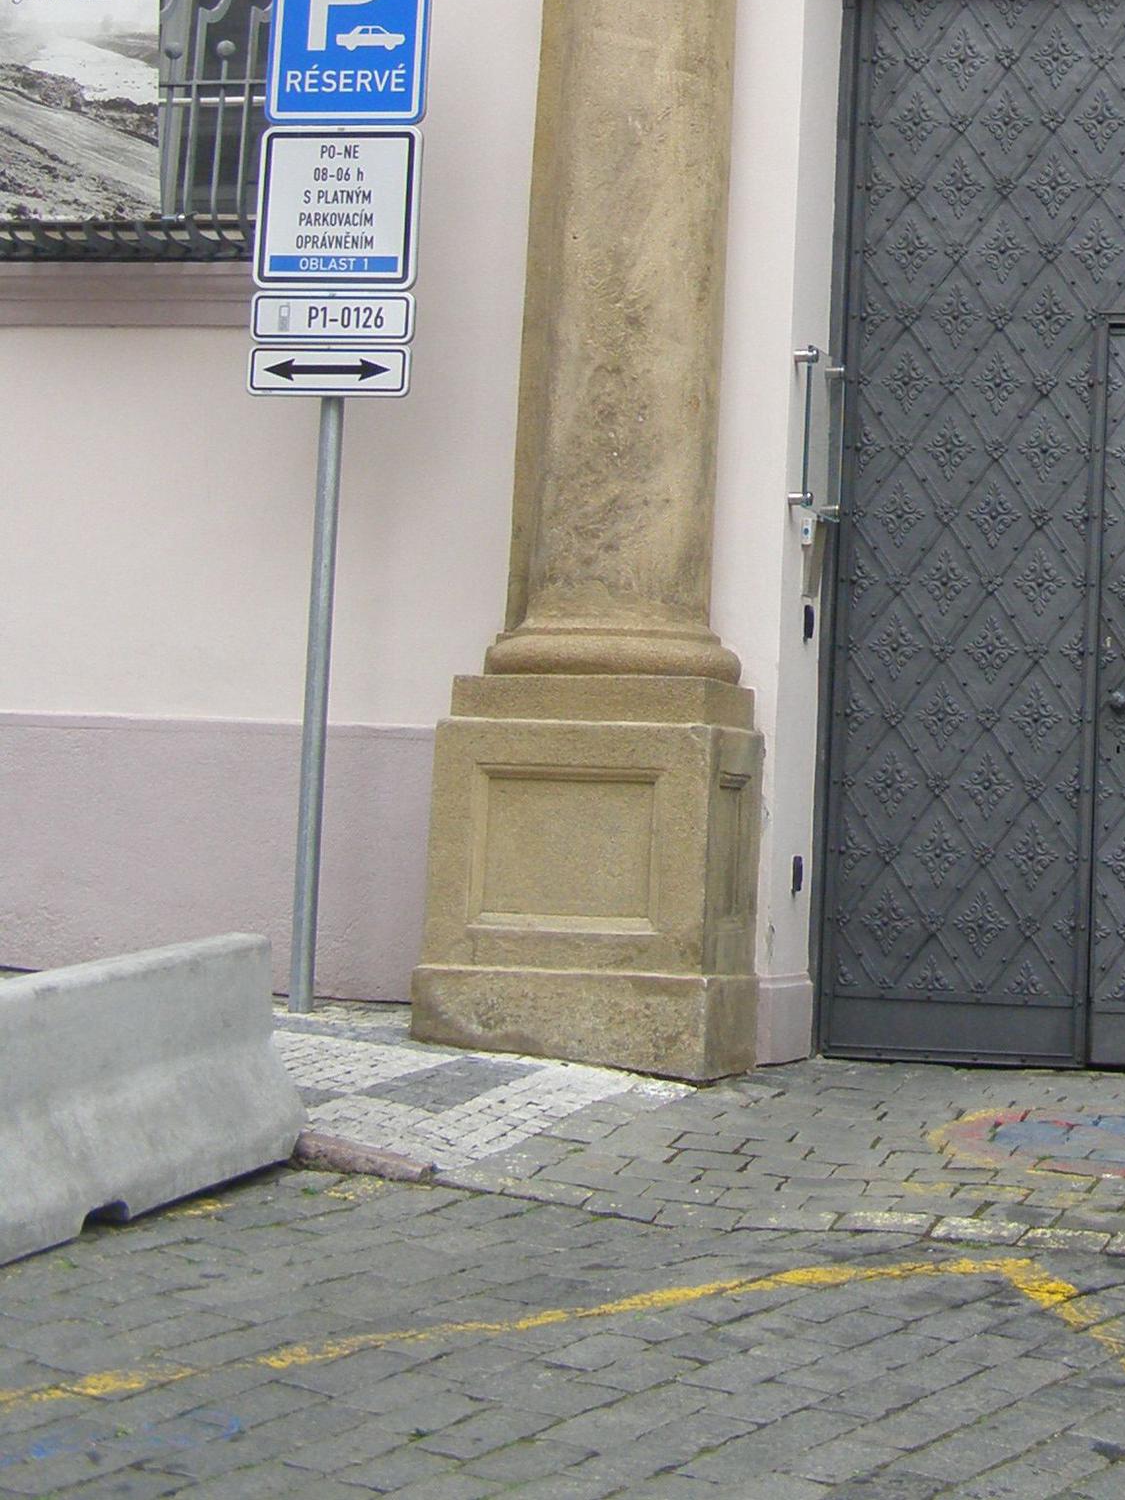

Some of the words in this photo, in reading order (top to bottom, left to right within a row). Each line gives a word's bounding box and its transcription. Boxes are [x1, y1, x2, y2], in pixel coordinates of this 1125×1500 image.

[286, 64, 407, 92] RÉSERVÉ
[320, 145, 360, 159] PO-NE
[313, 167, 351, 181] 08-06
[357, 167, 364, 181] h
[303, 190, 312, 204] S
[317, 186, 372, 204] PLATNÝM
[298, 209, 374, 227] PARKOVACÍM
[296, 232, 374, 249] OPRÁVNĚNÍM
[299, 258, 356, 271] OBLAST
[363, 258, 369, 271] 1
[307, 306, 384, 329] P1-0126
